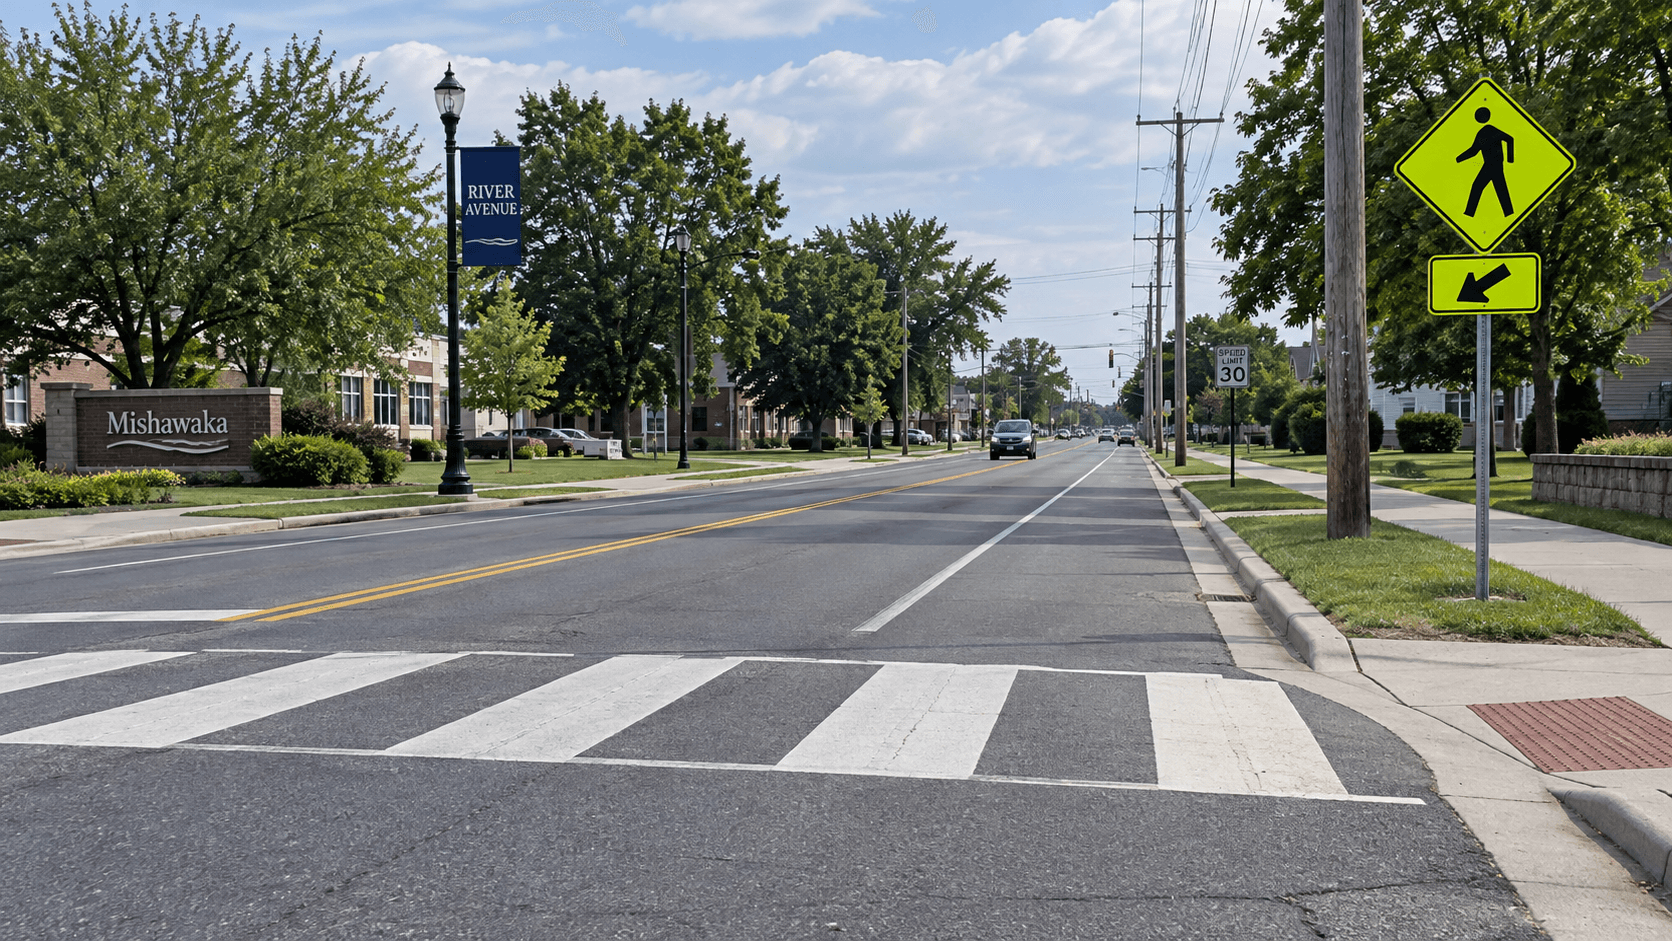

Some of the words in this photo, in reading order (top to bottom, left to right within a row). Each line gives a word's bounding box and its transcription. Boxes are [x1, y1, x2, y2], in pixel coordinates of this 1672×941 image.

[468, 184, 515, 199] RIVER
[465, 202, 518, 216] AVENUE
[1220, 366, 1246, 382] 30
[106, 409, 229, 435] Mishawaka
